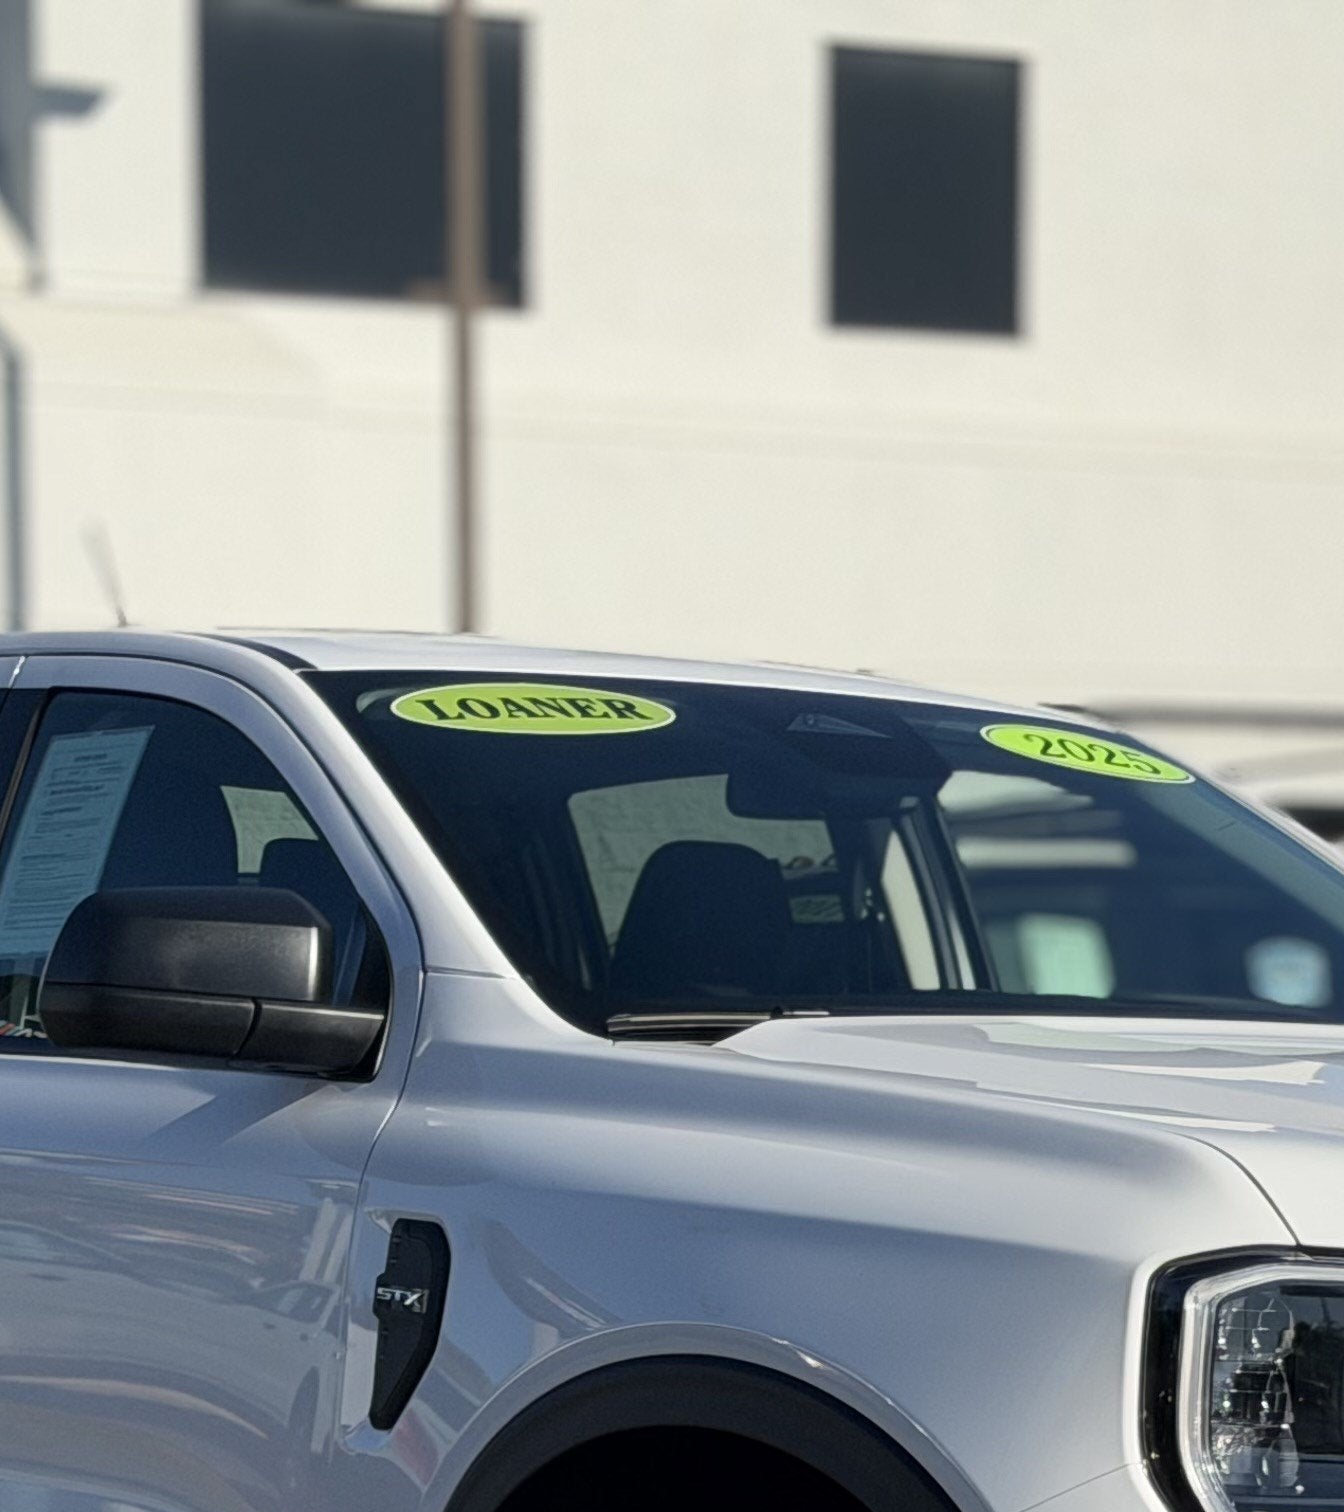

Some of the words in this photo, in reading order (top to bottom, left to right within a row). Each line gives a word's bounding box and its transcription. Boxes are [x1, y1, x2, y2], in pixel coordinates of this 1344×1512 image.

[415, 696, 654, 721] LOANER
[1022, 733, 1162, 775] 2025
[376, 1286, 427, 1313] STX
